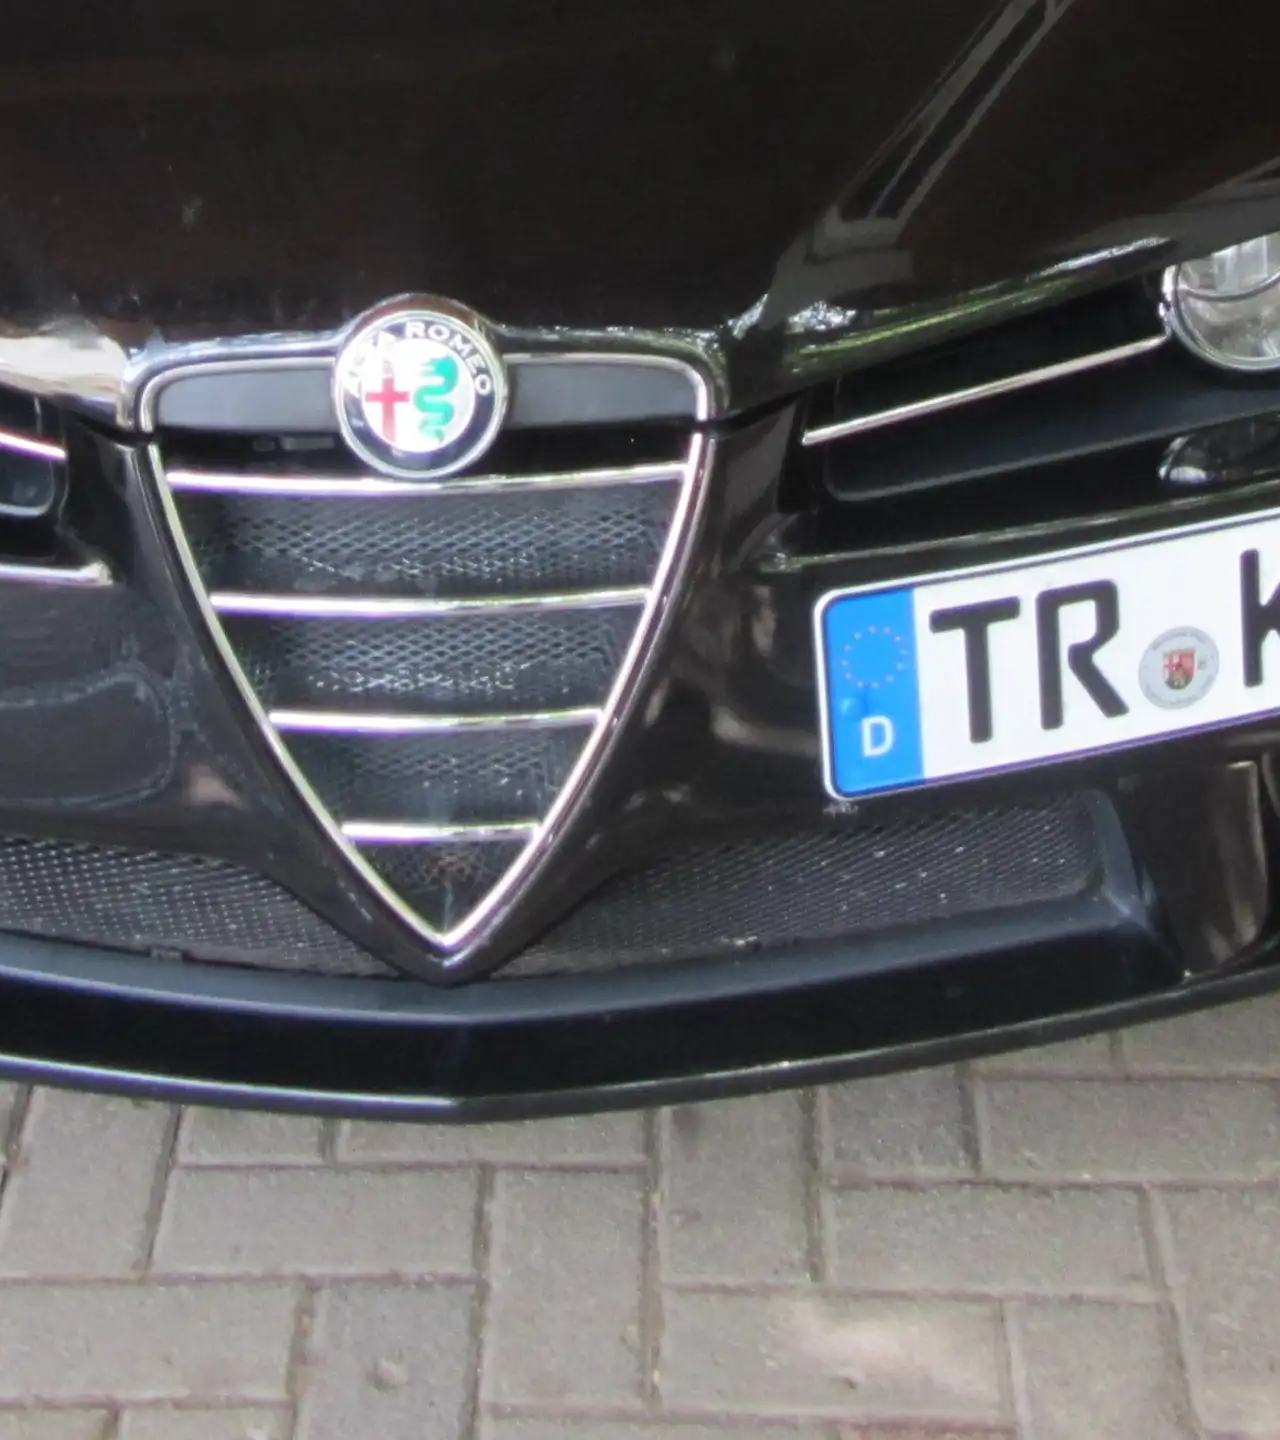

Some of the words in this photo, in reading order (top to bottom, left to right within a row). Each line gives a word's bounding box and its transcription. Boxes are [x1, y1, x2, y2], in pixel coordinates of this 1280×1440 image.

[403, 321, 492, 397] ROMEO
[928, 578, 1130, 744] TR
[861, 715, 896, 758] D
